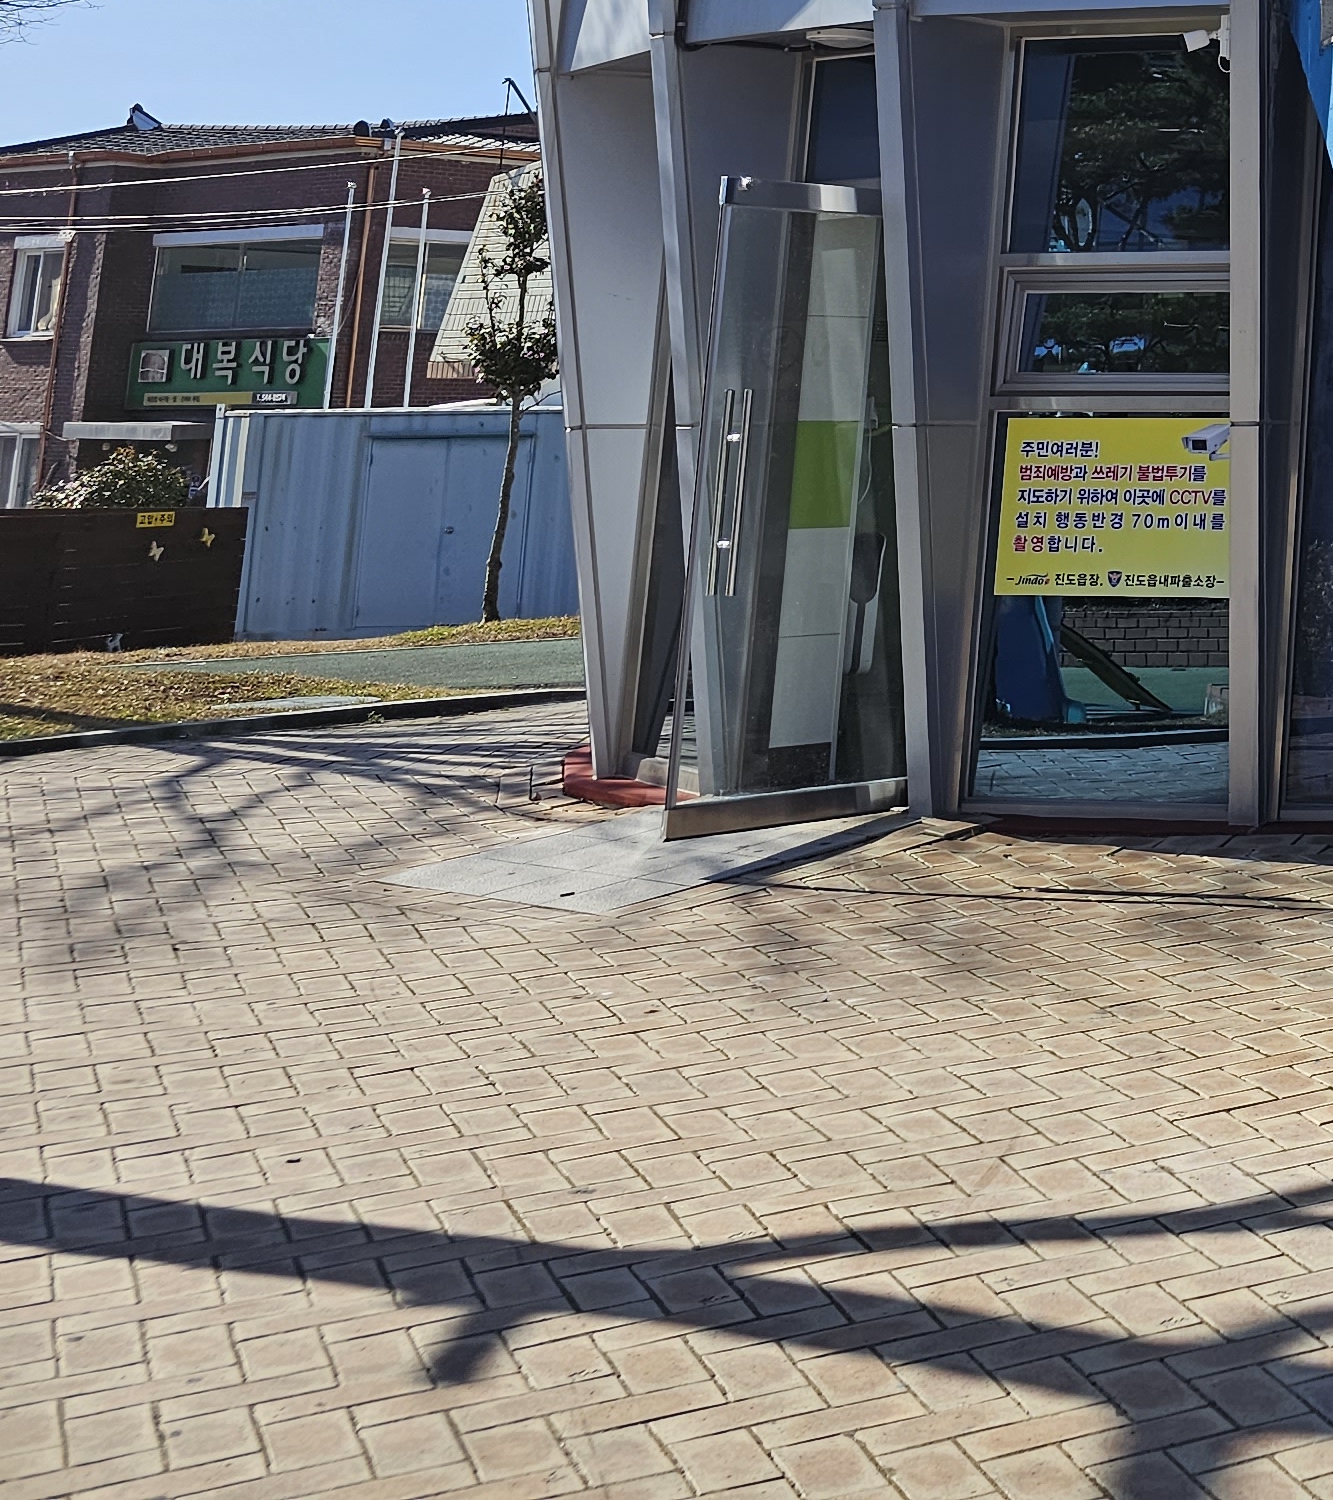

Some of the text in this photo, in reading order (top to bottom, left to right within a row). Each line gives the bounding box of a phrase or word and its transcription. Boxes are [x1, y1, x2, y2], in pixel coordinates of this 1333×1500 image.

[180, 339, 308, 386] 대복식당
[1020, 440, 1100, 458] 주민여러분!
[1019, 464, 1208, 482] 범죄예방과 쓰레기 불법투기를
[1017, 487, 1227, 506] 지도하기 위하여 이곳에 CCTV를
[1015, 511, 1048, 530] 설치
[1055, 511, 1125, 530] 행동반경
[1012, 534, 1104, 554] 촬영합니다.
